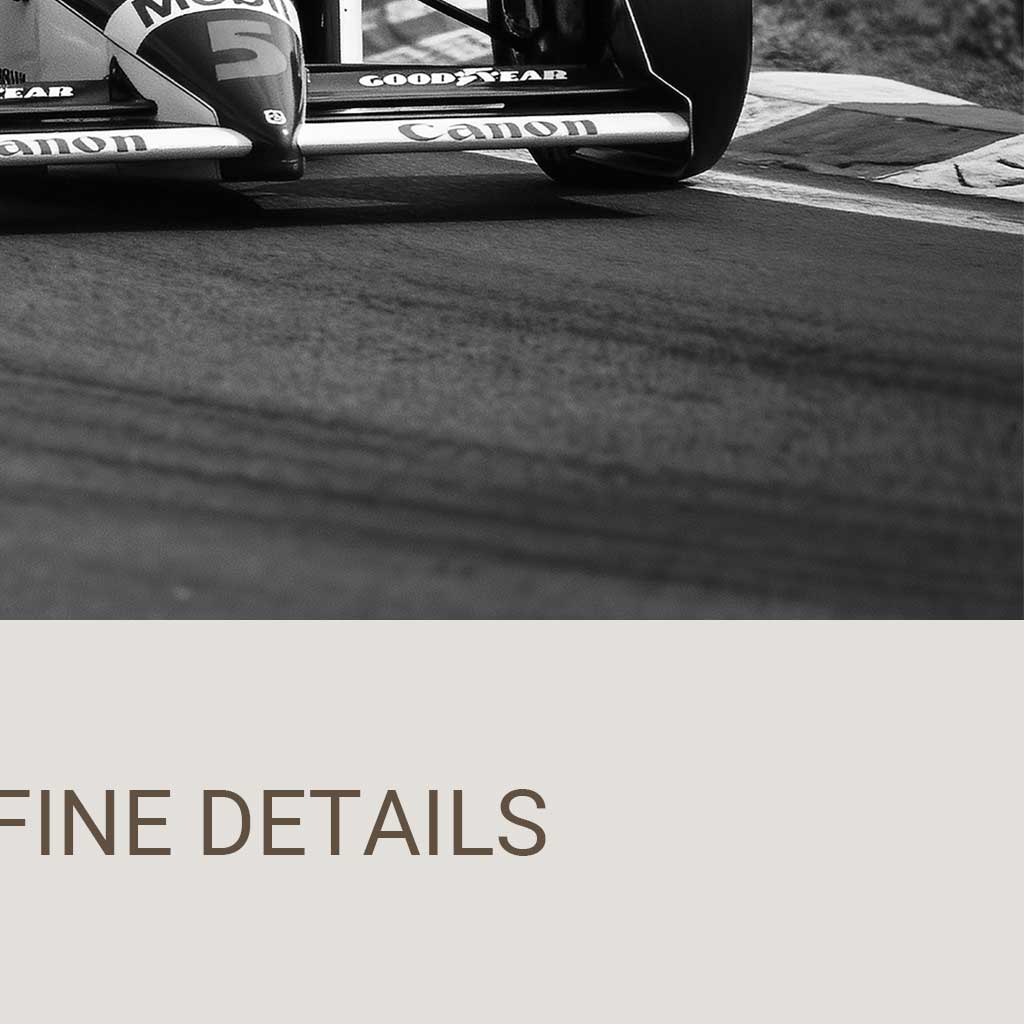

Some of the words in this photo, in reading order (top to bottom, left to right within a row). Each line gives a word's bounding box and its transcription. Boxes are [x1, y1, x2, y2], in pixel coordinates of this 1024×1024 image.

[207, 19, 288, 82] 5
[359, 67, 568, 87] GOODYEAR
[398, 118, 599, 142] Canon
